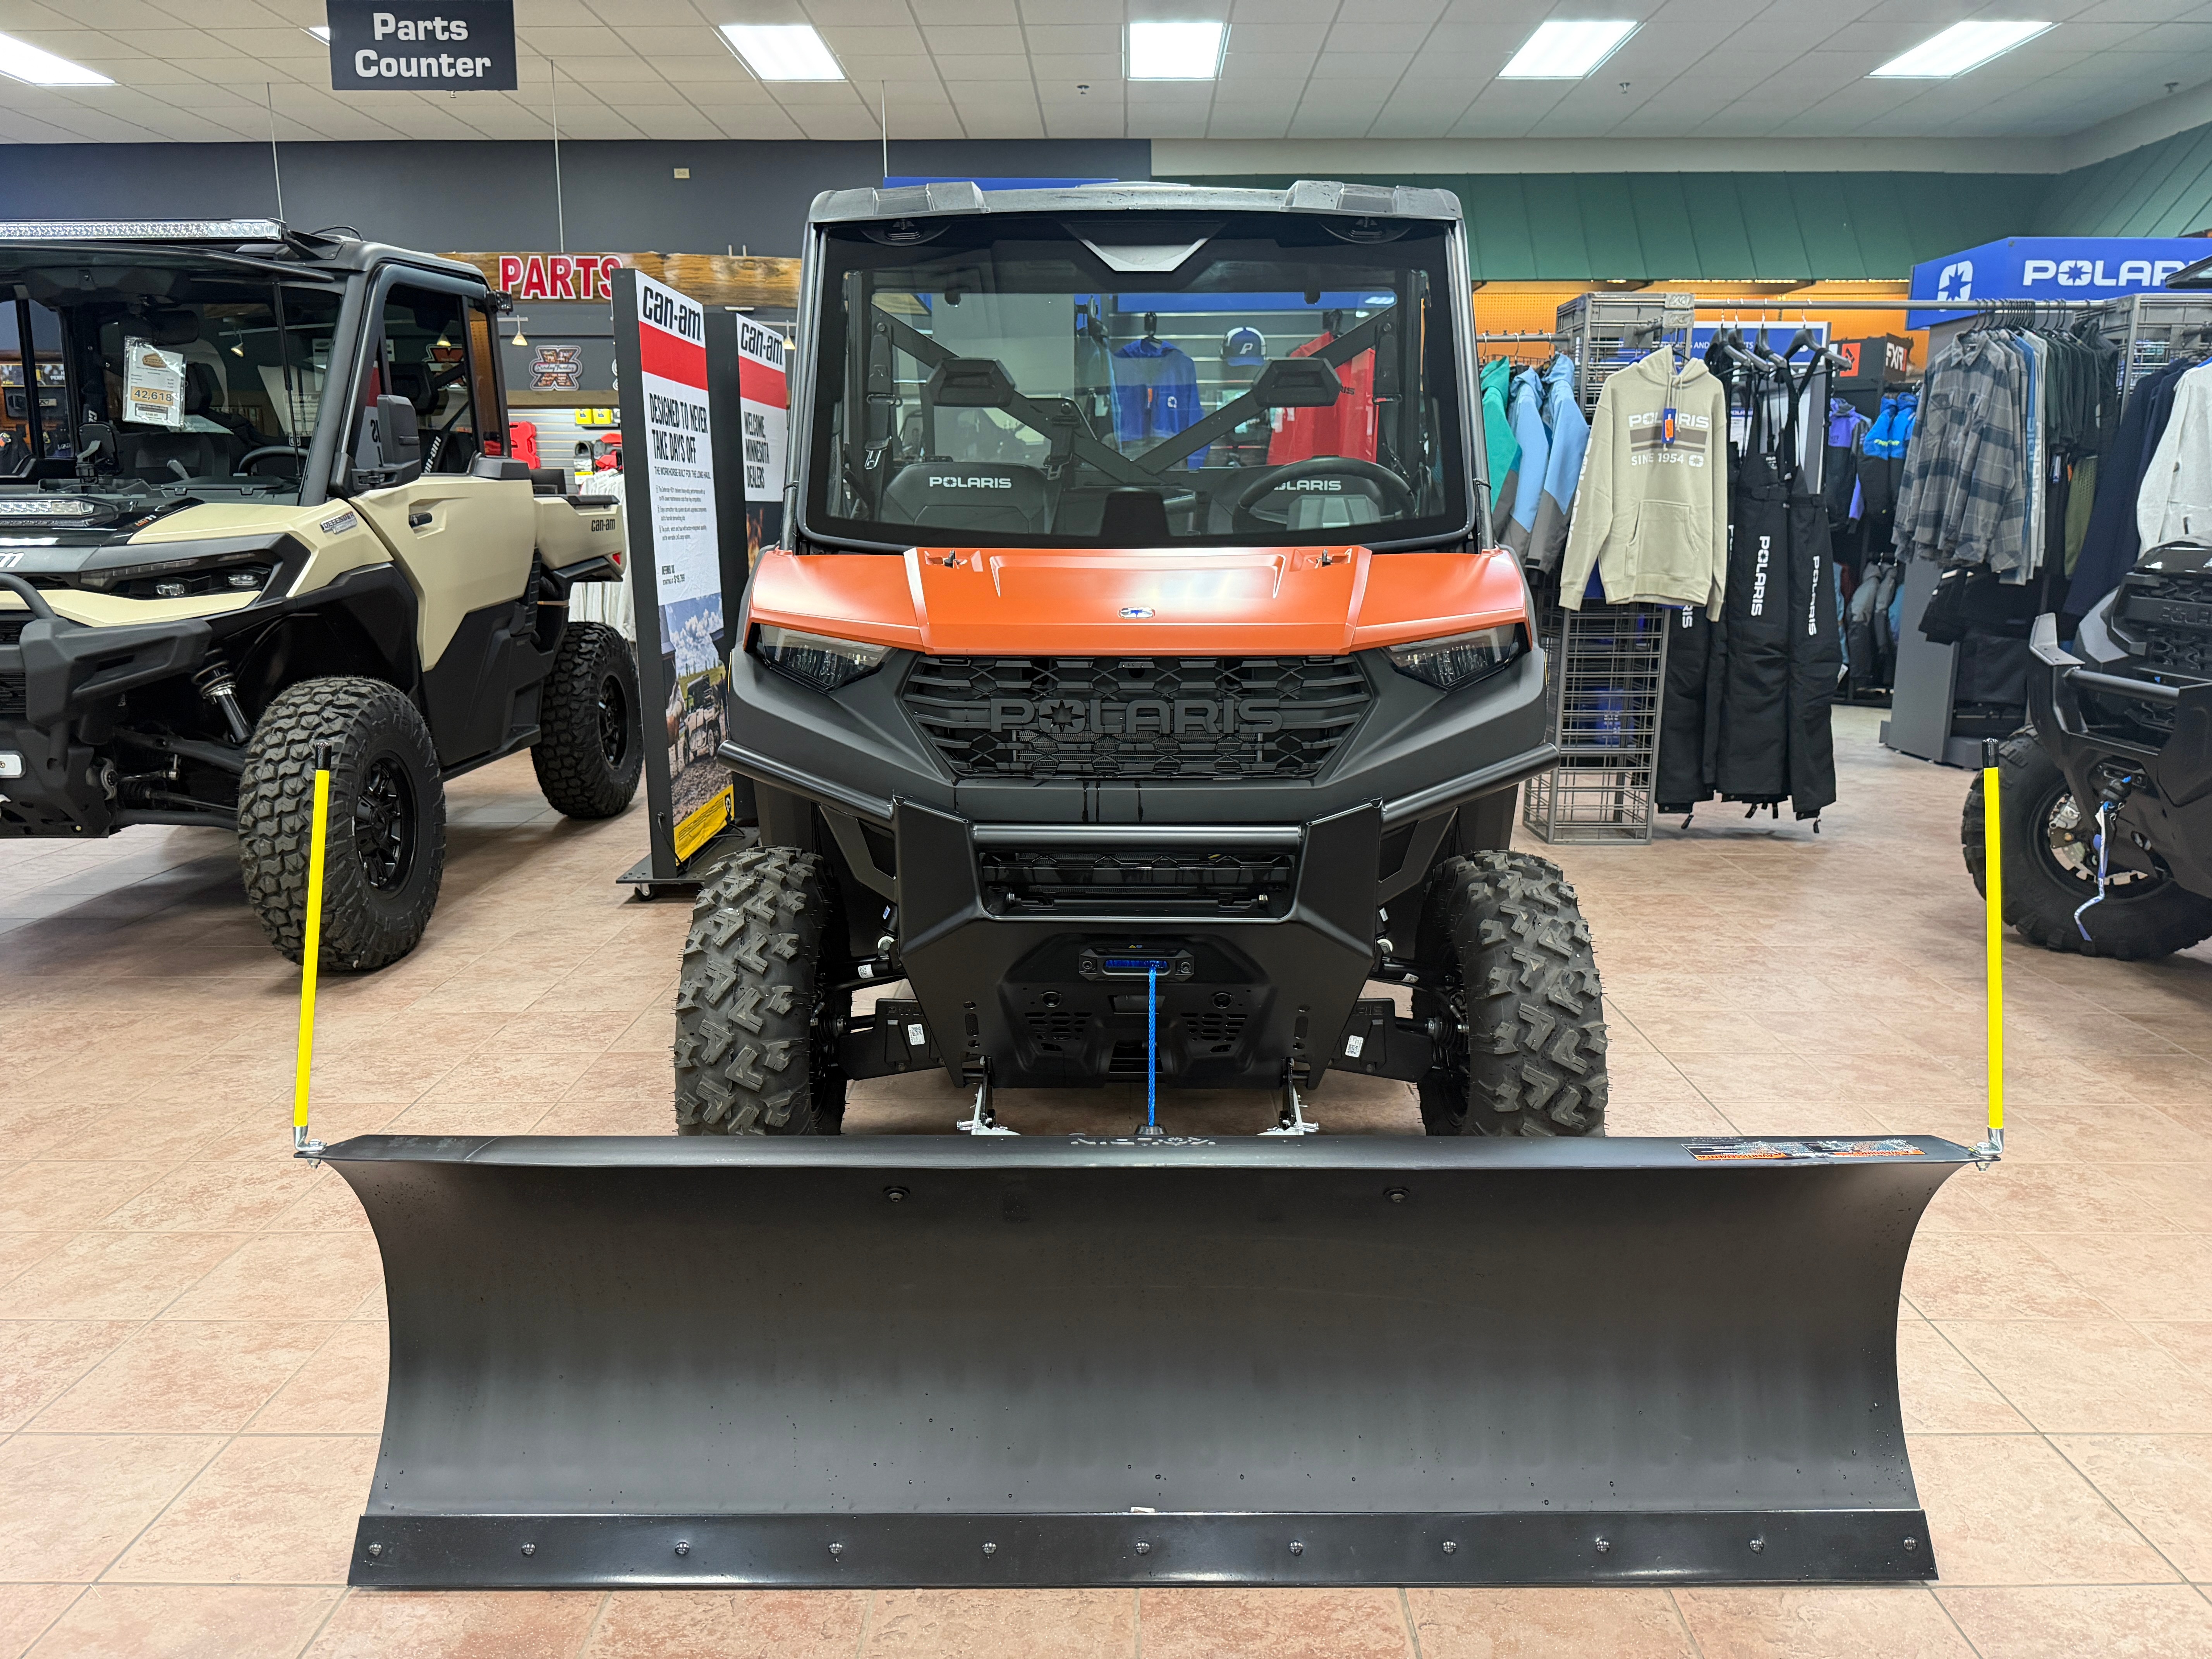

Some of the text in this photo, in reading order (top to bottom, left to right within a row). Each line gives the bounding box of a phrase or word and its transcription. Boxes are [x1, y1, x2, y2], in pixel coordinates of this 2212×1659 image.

[373, 13, 468, 42] Parts
[354, 49, 491, 79] Counter
[500, 255, 622, 300] PARTS
[2023, 260, 2198, 286] POLAR
[642, 285, 701, 342] can-am
[741, 323, 783, 365] can-am
[1886, 342, 1905, 371] FXR
[134, 390, 172, 402] 42,618
[649, 393, 708, 433] DESIGNED TO NEVER
[424, 436, 441, 473] an-am
[652, 429, 696, 464] TAKE DAYS OFF
[1658, 452, 1684, 464] 1954
[747, 465, 765, 489] DEALERS
[929, 476, 1012, 489] POLARIS
[1274, 480, 1341, 491] LARIS
[323, 512, 354, 529] DEFENDER
[591, 518, 615, 532] can-am
[1751, 536, 1770, 616] POLARIS
[1808, 555, 1820, 635] POLARIS
[990, 699, 1283, 734] POLARIS
